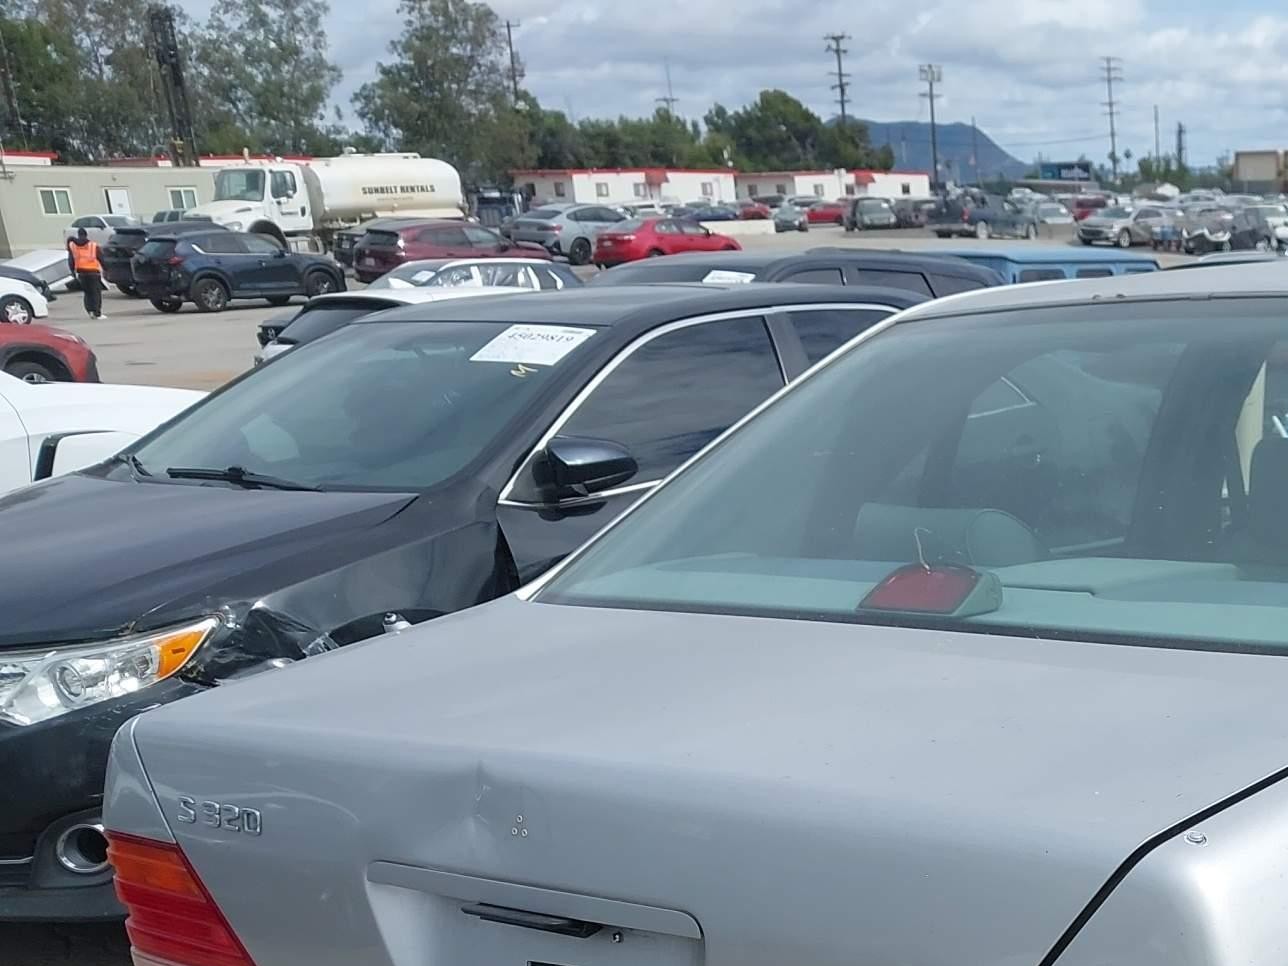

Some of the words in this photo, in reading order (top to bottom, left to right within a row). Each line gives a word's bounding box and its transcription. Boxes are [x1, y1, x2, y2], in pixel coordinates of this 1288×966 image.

[362, 186, 398, 195] SUNBELT
[400, 185, 435, 193] RENTALS
[177, 795, 196, 824] S
[201, 800, 263, 836] 320
